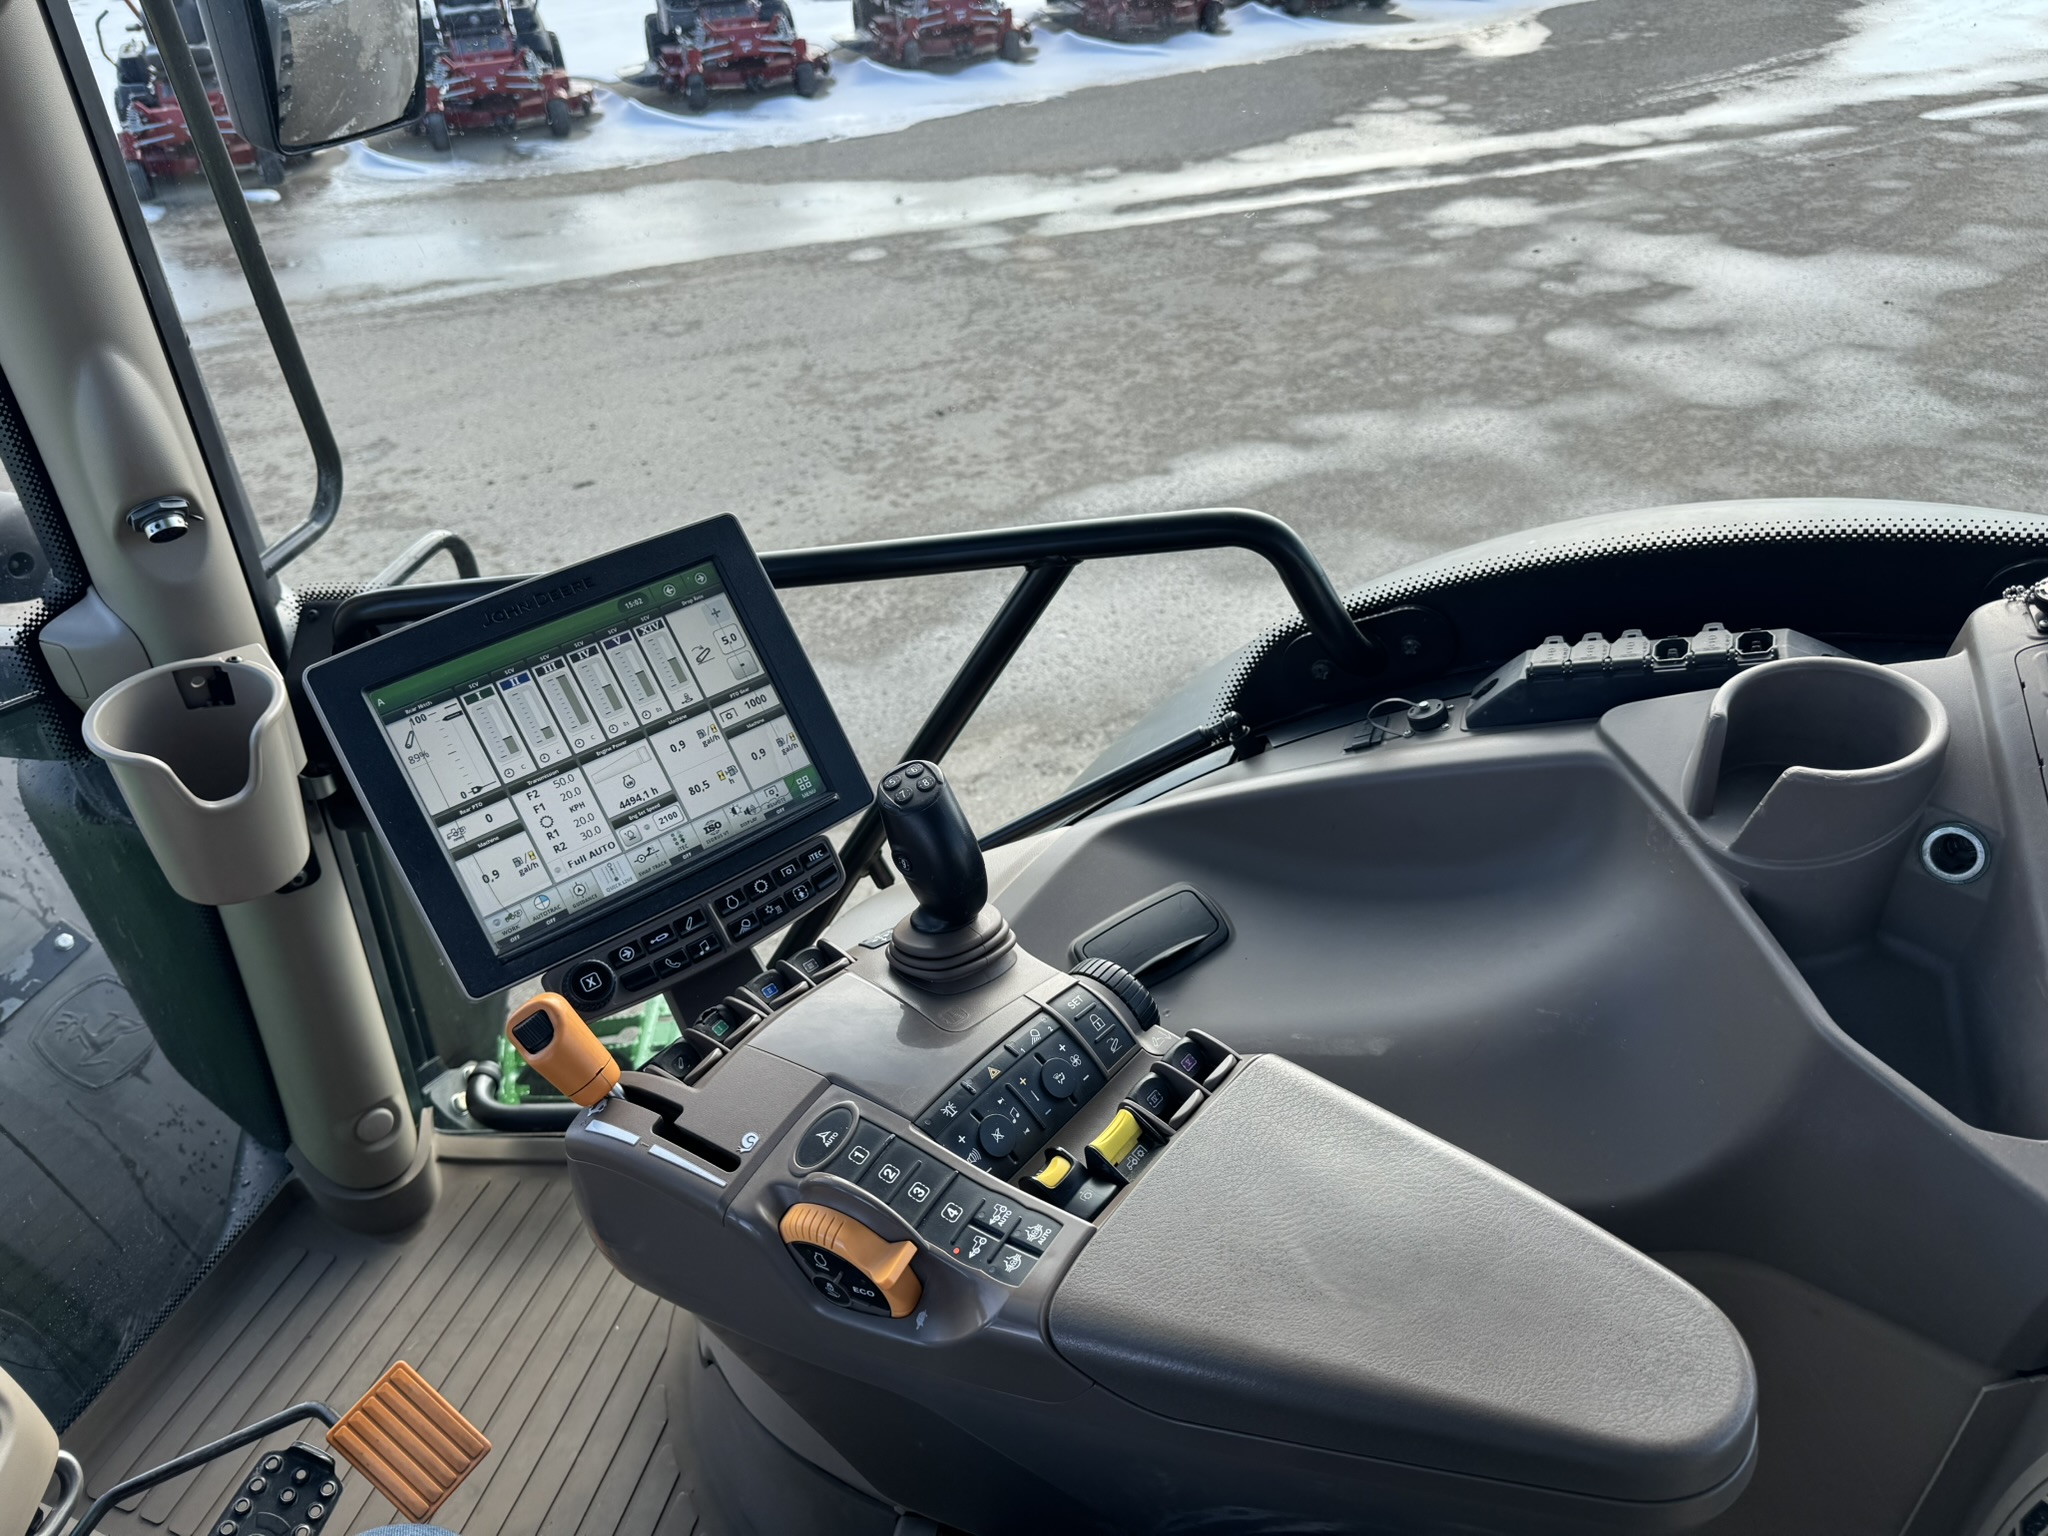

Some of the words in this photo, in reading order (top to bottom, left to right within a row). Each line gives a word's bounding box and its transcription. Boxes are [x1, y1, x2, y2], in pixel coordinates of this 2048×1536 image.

[482, 603, 531, 628] JOHN
[533, 577, 595, 608] DEERE
[624, 598, 643, 609] 15:02
[639, 621, 660, 635] XIV
[612, 636, 622, 646] V
[578, 649, 590, 660] IV
[542, 662, 557, 674] III
[378, 698, 385, 706] A
[729, 691, 740, 700] PTO
[744, 694, 767, 710] 1000
[404, 706, 416, 714] Rear
[418, 700, 432, 708] Hitch
[409, 714, 428, 726] 100
[668, 714, 688, 726] Machine
[746, 718, 765, 728] Machine
[669, 740, 686, 754] 0,9
[702, 734, 720, 748] gal/h
[596, 744, 612, 756] Engine
[612, 740, 627, 750] Power
[751, 748, 766, 761] 0,9
[781, 742, 798, 756] gal/h
[408, 750, 430, 764] 89%
[526, 770, 560, 786] Transmission
[922, 778, 930, 786] 8
[526, 789, 540, 800] F2
[552, 774, 574, 788] 50.0
[688, 780, 710, 796] 80,5
[801, 788, 816, 799] MENU
[460, 791, 467, 800] 0
[533, 803, 546, 814] F1
[560, 786, 582, 802] 20.0
[619, 790, 650, 810] 4494,1
[650, 786, 659, 796] h
[898, 790, 906, 798] 7
[459, 807, 472, 816] Rear
[472, 802, 484, 810] PTO
[568, 801, 586, 814] KPH
[628, 812, 638, 820] Eng
[646, 803, 661, 814] Speed
[484, 814, 493, 824] 0
[658, 812, 678, 825] 2100
[740, 817, 758, 828] DISPLAY
[546, 829, 560, 840] R1
[573, 812, 595, 828] 20.0
[703, 821, 722, 834] ISO
[478, 836, 500, 848] Machine
[552, 842, 568, 854] R2
[580, 826, 602, 841] 30.0
[567, 855, 586, 869] Full
[589, 842, 616, 859] AUTO
[808, 850, 824, 862] iTEC
[518, 862, 540, 877] gal/h
[652, 860, 667, 870] TRACK
[482, 870, 500, 884] 0,9
[606, 882, 620, 892] QUICK
[572, 894, 598, 908] GUIDANCE
[532, 904, 562, 921] AUTOTRAC
[502, 924, 520, 936] WORK
[1067, 995, 1084, 1010] SET
[824, 1132, 838, 1147] AUTO
[853, 1150, 866, 1159] 1
[884, 1168, 896, 1180] 2
[913, 1186, 926, 1198] 3
[946, 1206, 958, 1218] 4
[998, 1210, 1012, 1227] AUTO
[1038, 1228, 1052, 1246] AUTO
[852, 1286, 875, 1298] ECO
